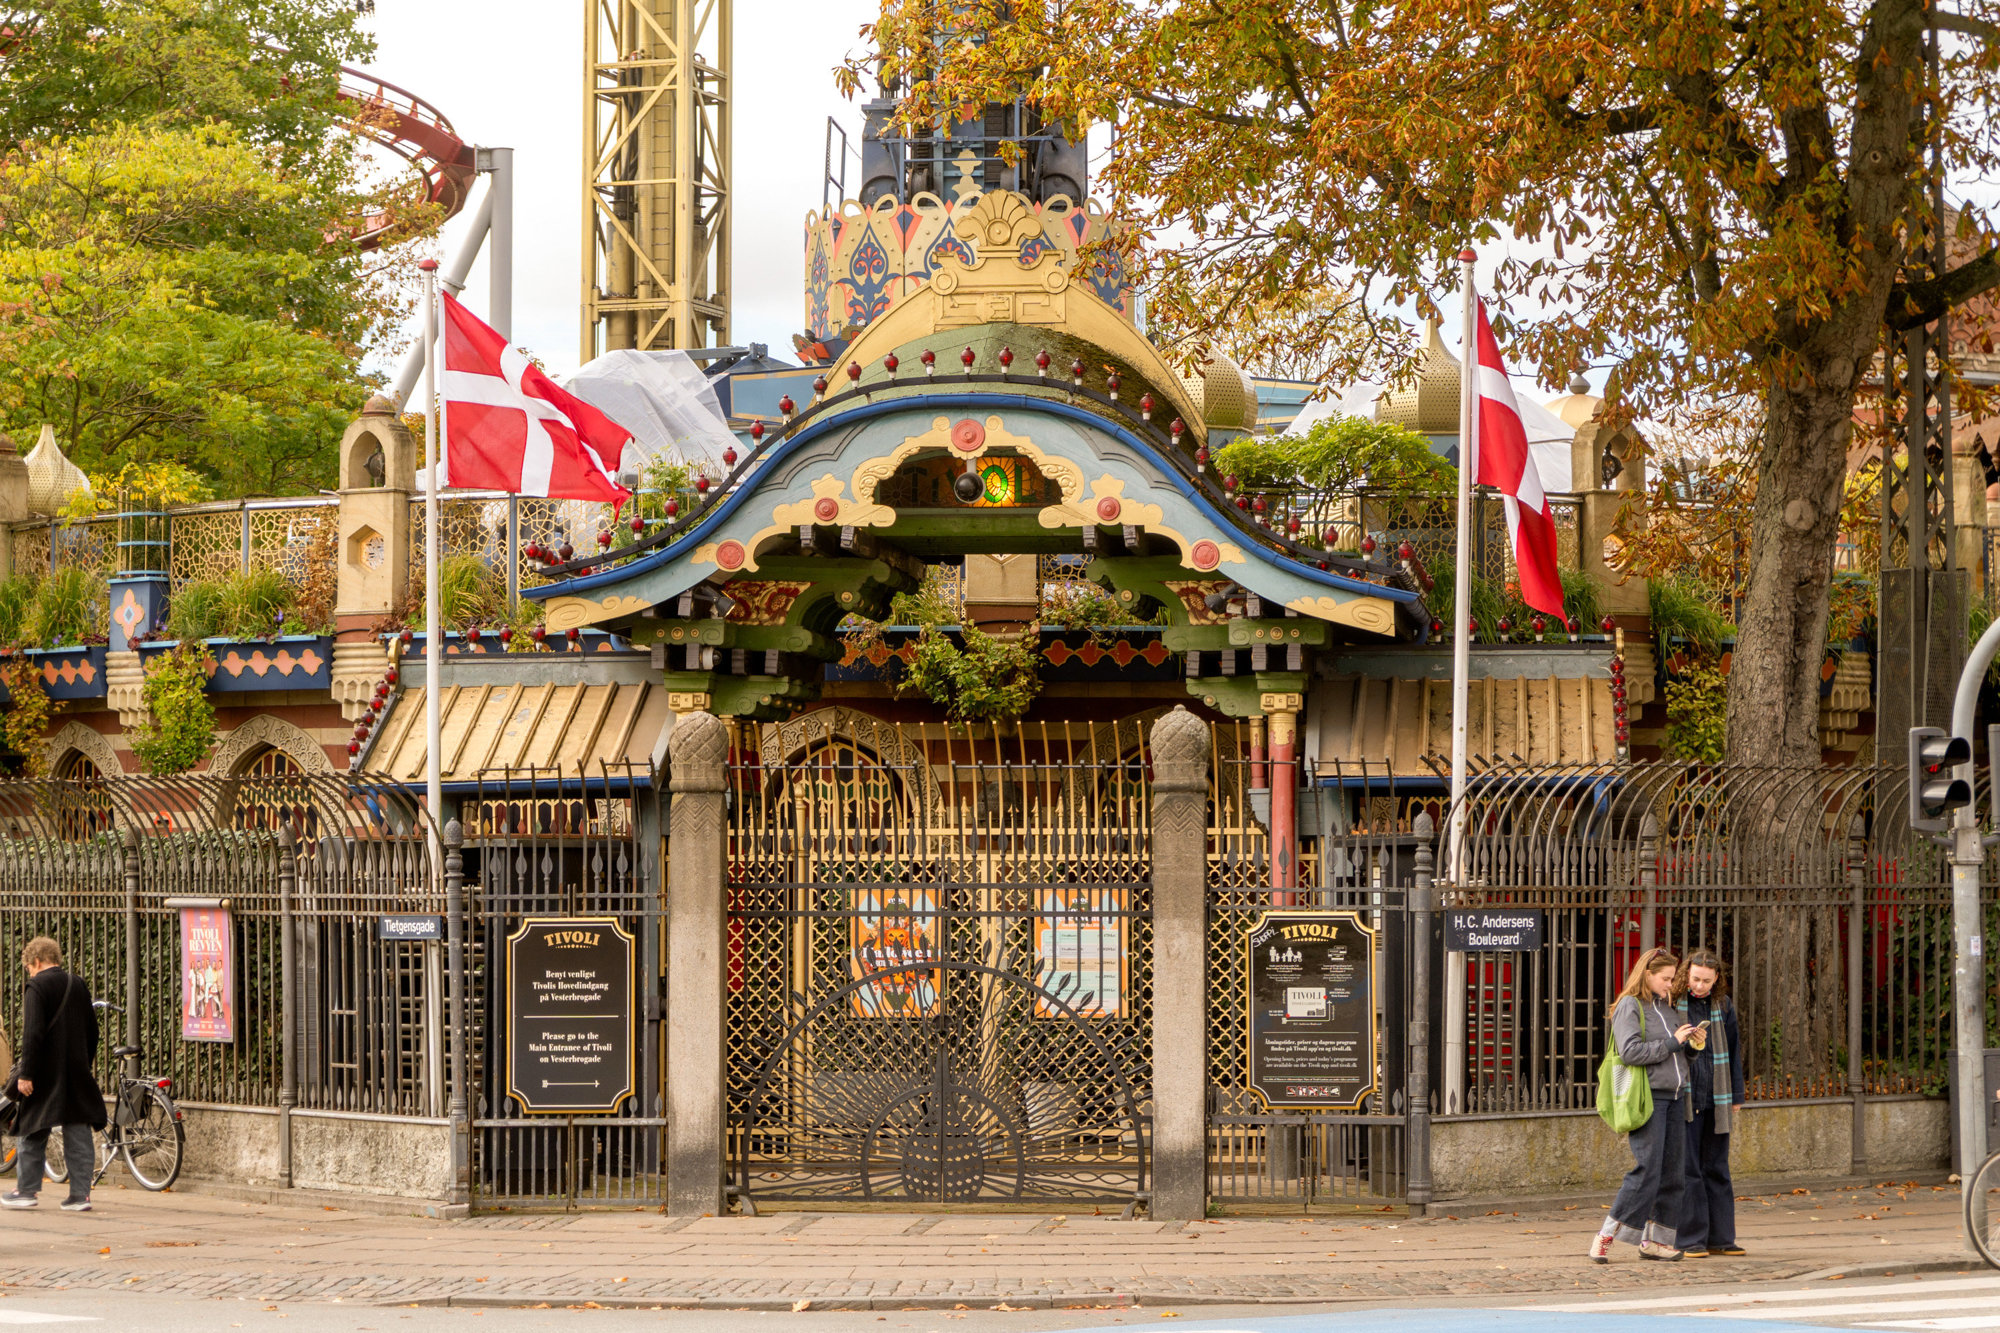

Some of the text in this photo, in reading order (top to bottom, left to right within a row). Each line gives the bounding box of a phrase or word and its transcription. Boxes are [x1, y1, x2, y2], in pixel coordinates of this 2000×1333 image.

[903, 463, 1051, 503] TIOLI
[1482, 914, 1534, 928] Andersens
[384, 920, 434, 935] Tietgensgade
[1280, 924, 1339, 940] TIVOLI
[190, 928, 218, 940] TIVOLI
[543, 931, 600, 947] TIVOLI
[1468, 932, 1520, 946] Boulevard
[189, 940, 222, 952] REVYEN
[545, 970, 596, 980] Benyt venligst
[558, 982, 609, 991] Hovedindgang
[540, 993, 601, 1003] på Vesterbrogade
[528, 1044, 546, 1052] Main
[549, 1044, 580, 1052] Entrance
[583, 1044, 590, 1052] of
[550, 1055, 601, 1064] Vesterbrogade
